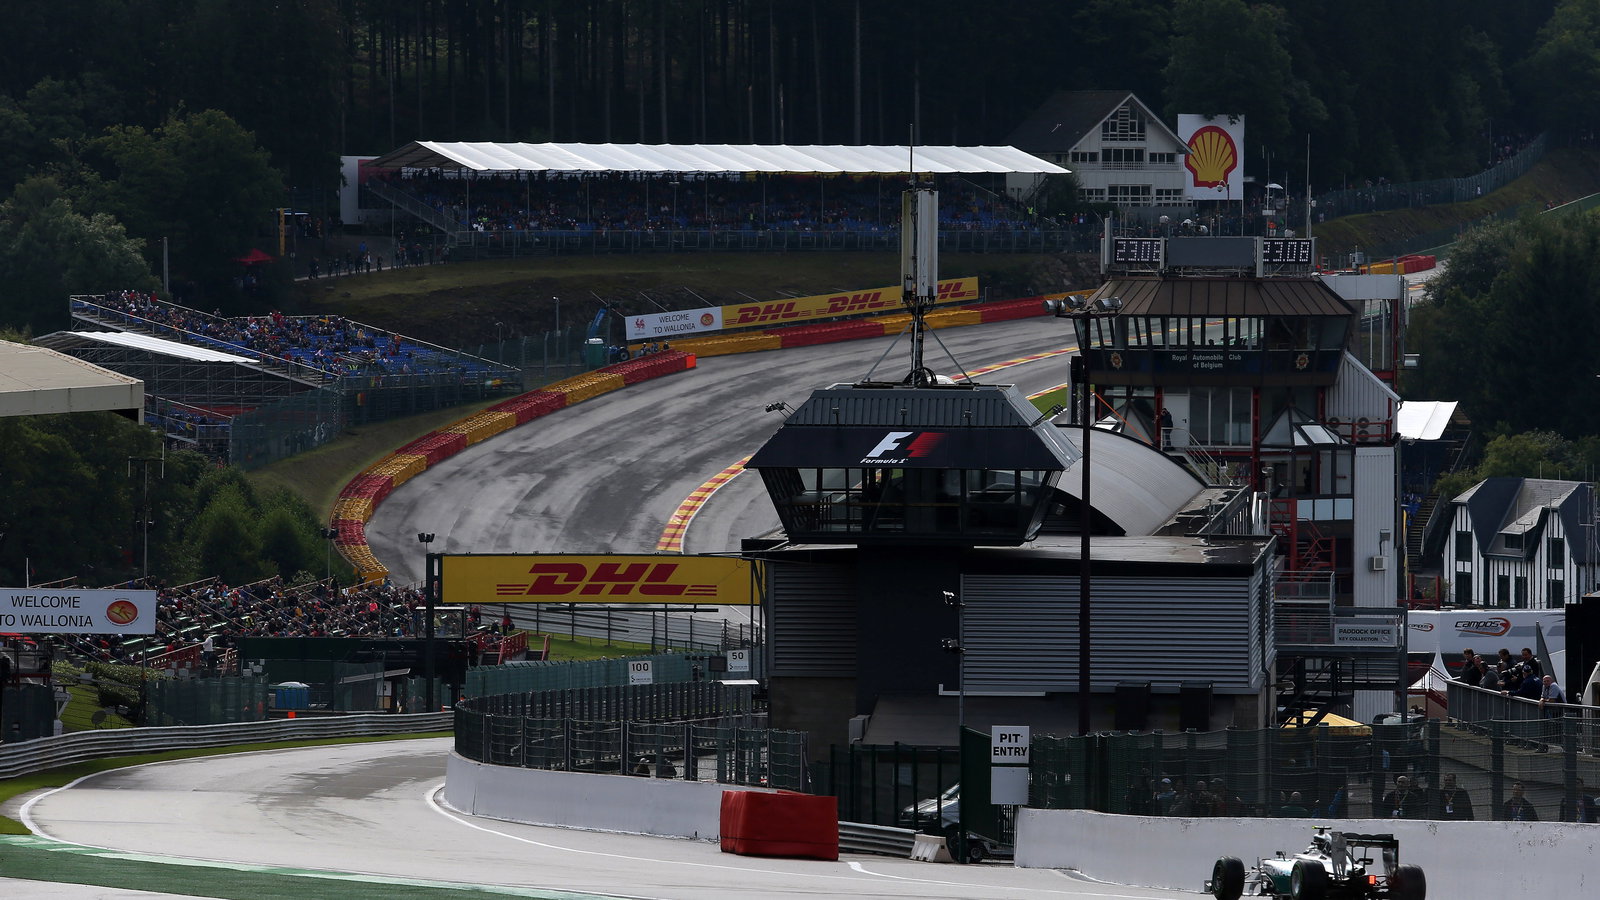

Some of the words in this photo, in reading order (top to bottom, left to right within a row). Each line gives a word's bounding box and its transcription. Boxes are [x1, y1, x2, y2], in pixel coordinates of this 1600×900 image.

[827, 291, 885, 314] DHL
[737, 301, 800, 324] DHL
[659, 313, 690, 323] WELCOME
[653, 326, 663, 334] TO
[663, 322, 696, 332] WALLONIA
[1171, 354, 1188, 362] Royal
[1228, 353, 1242, 361] Club
[1200, 361, 1223, 369] Belgium
[525, 563, 688, 596] DHL
[11, 595, 81, 608] WELCOME
[20, 614, 93, 627] WALLONIA
[732, 652, 744, 660] 50
[632, 663, 649, 672] 100
[1000, 734, 1020, 743] PIT
[993, 747, 1028, 756] ENTRY
